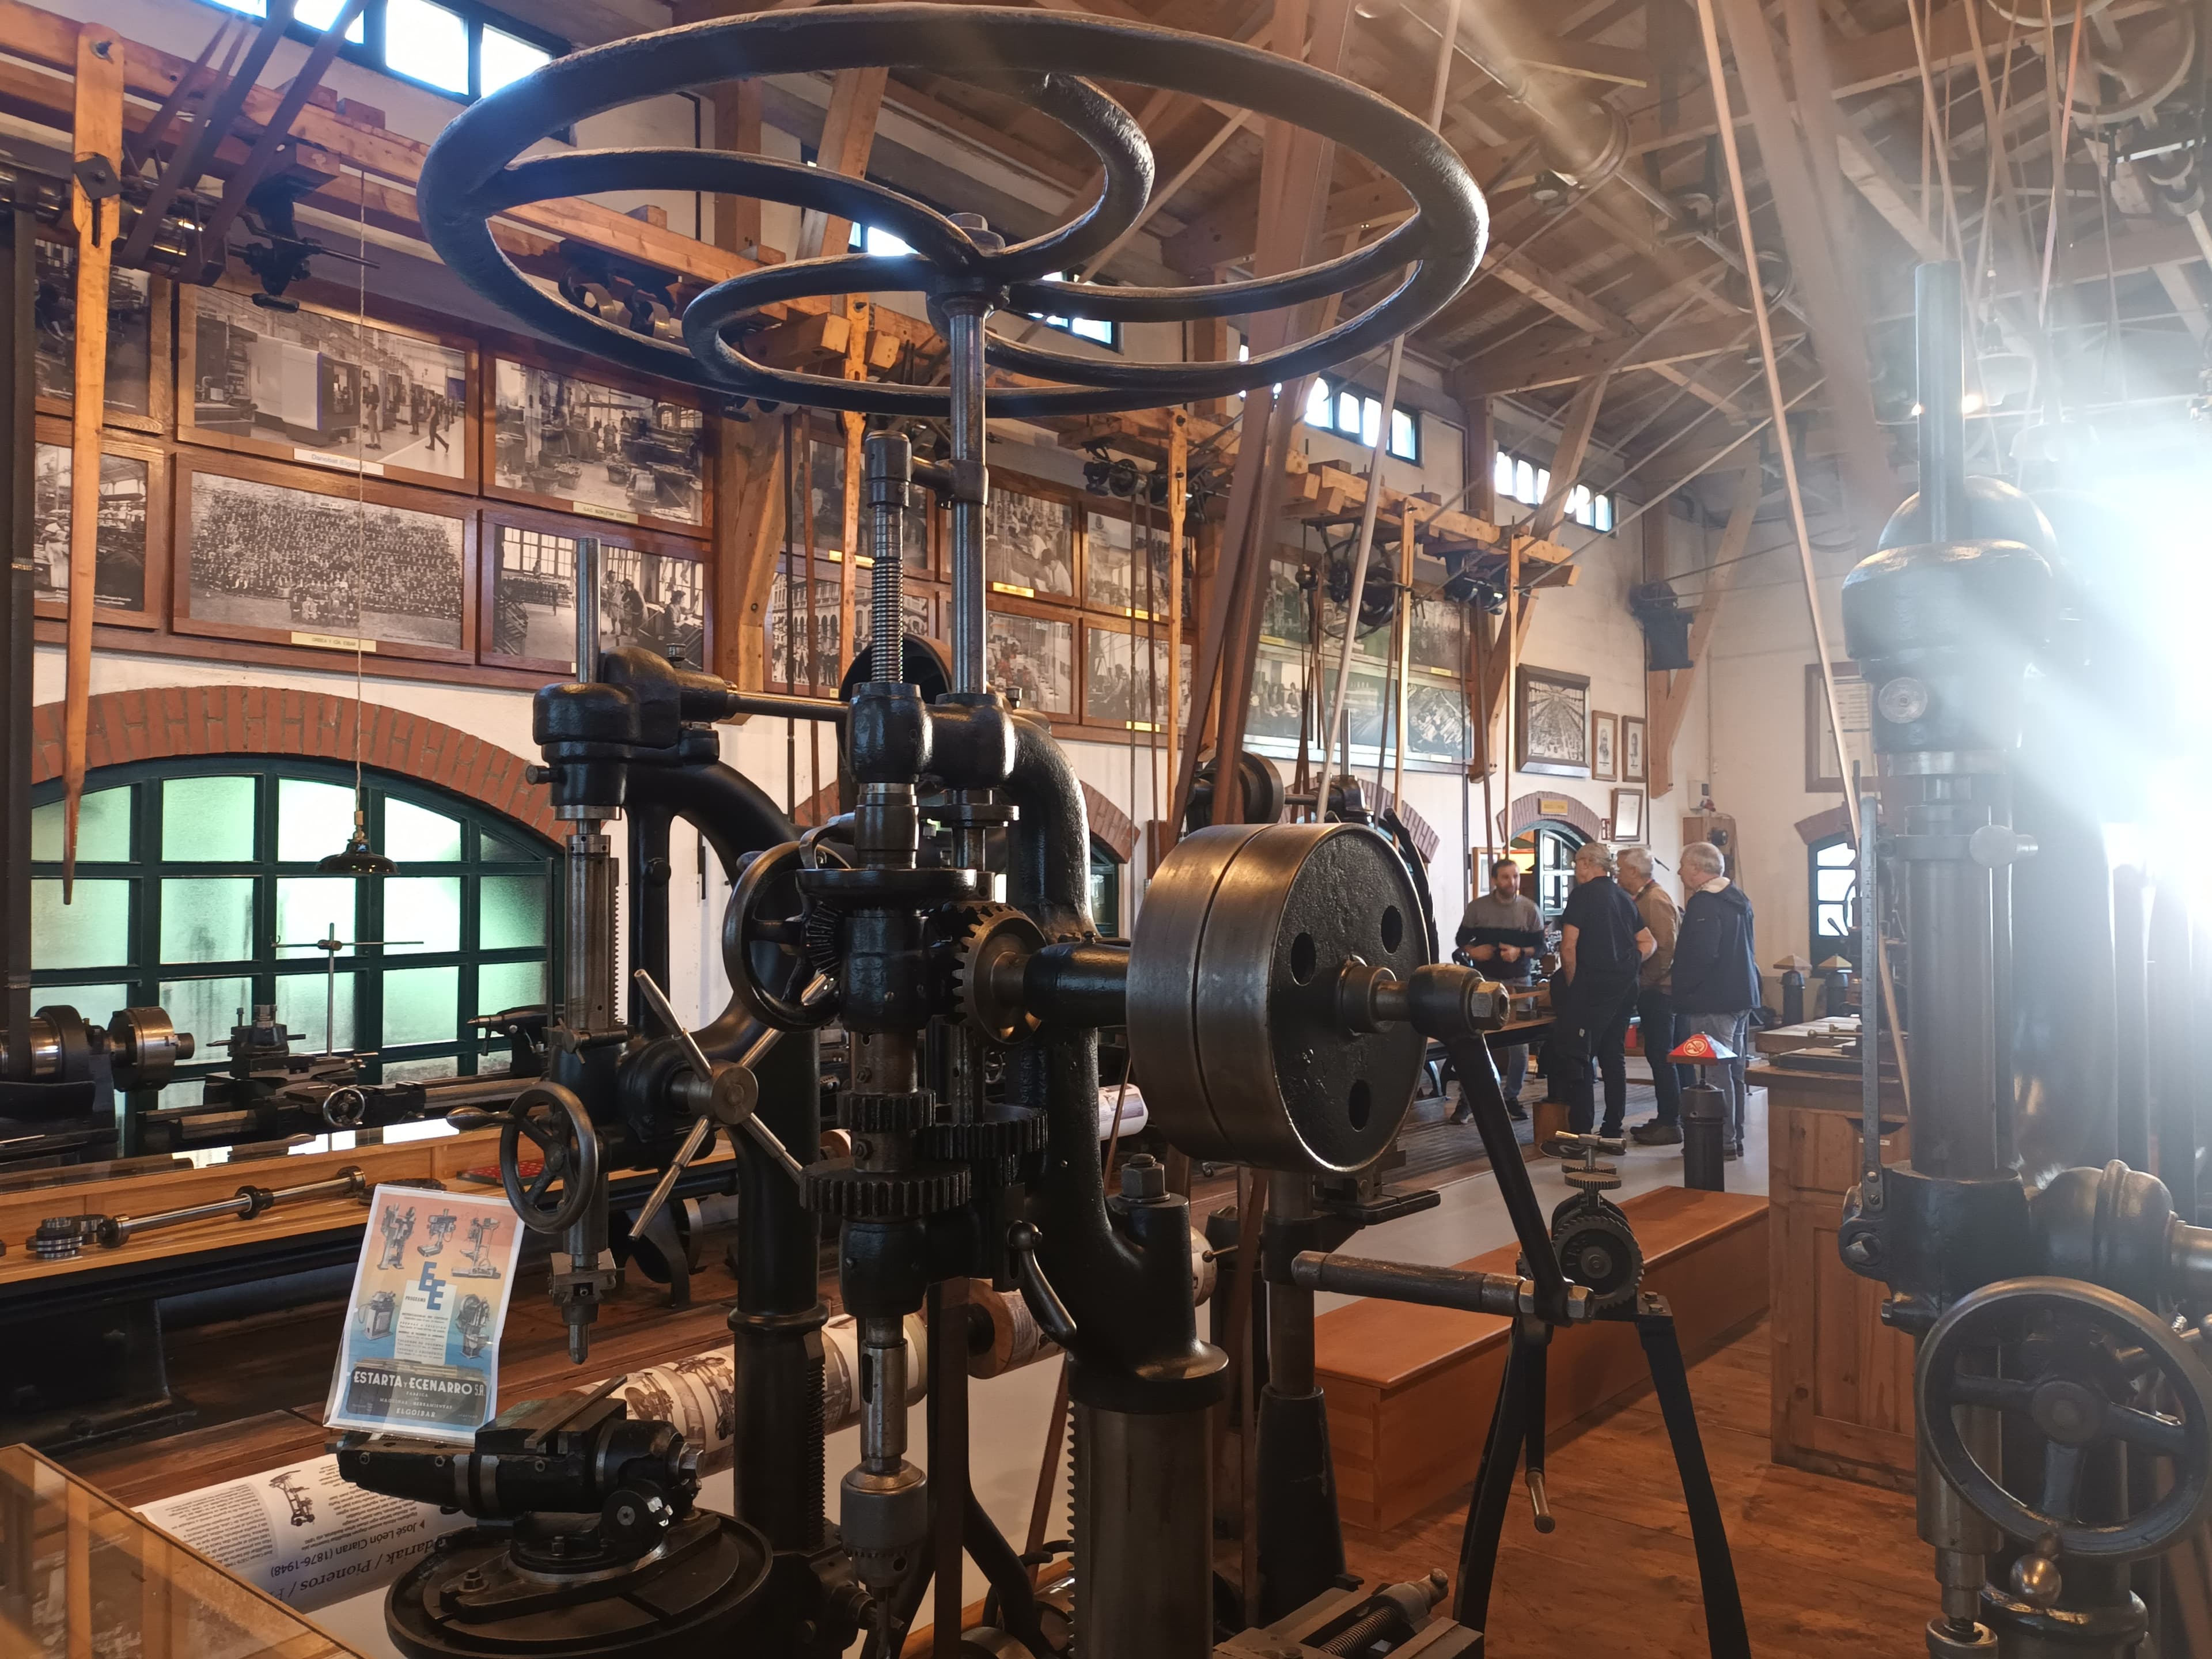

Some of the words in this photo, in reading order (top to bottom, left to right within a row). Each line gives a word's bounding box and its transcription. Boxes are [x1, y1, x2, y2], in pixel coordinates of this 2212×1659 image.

[354, 1371, 402, 1388] ESTARTA
[409, 1377, 472, 1395] ECENARRO
[474, 1384, 486, 1396] S.A.
[396, 1408, 436, 1418] ELGOIBAR
[369, 1530, 394, 1544] León
[396, 1522, 418, 1536] José
[335, 1539, 368, 1555] Ciaran
[386, 1539, 434, 1565] dariak
[271, 1550, 333, 1578] (1876-1948)
[300, 1559, 372, 1592] Pioneros
